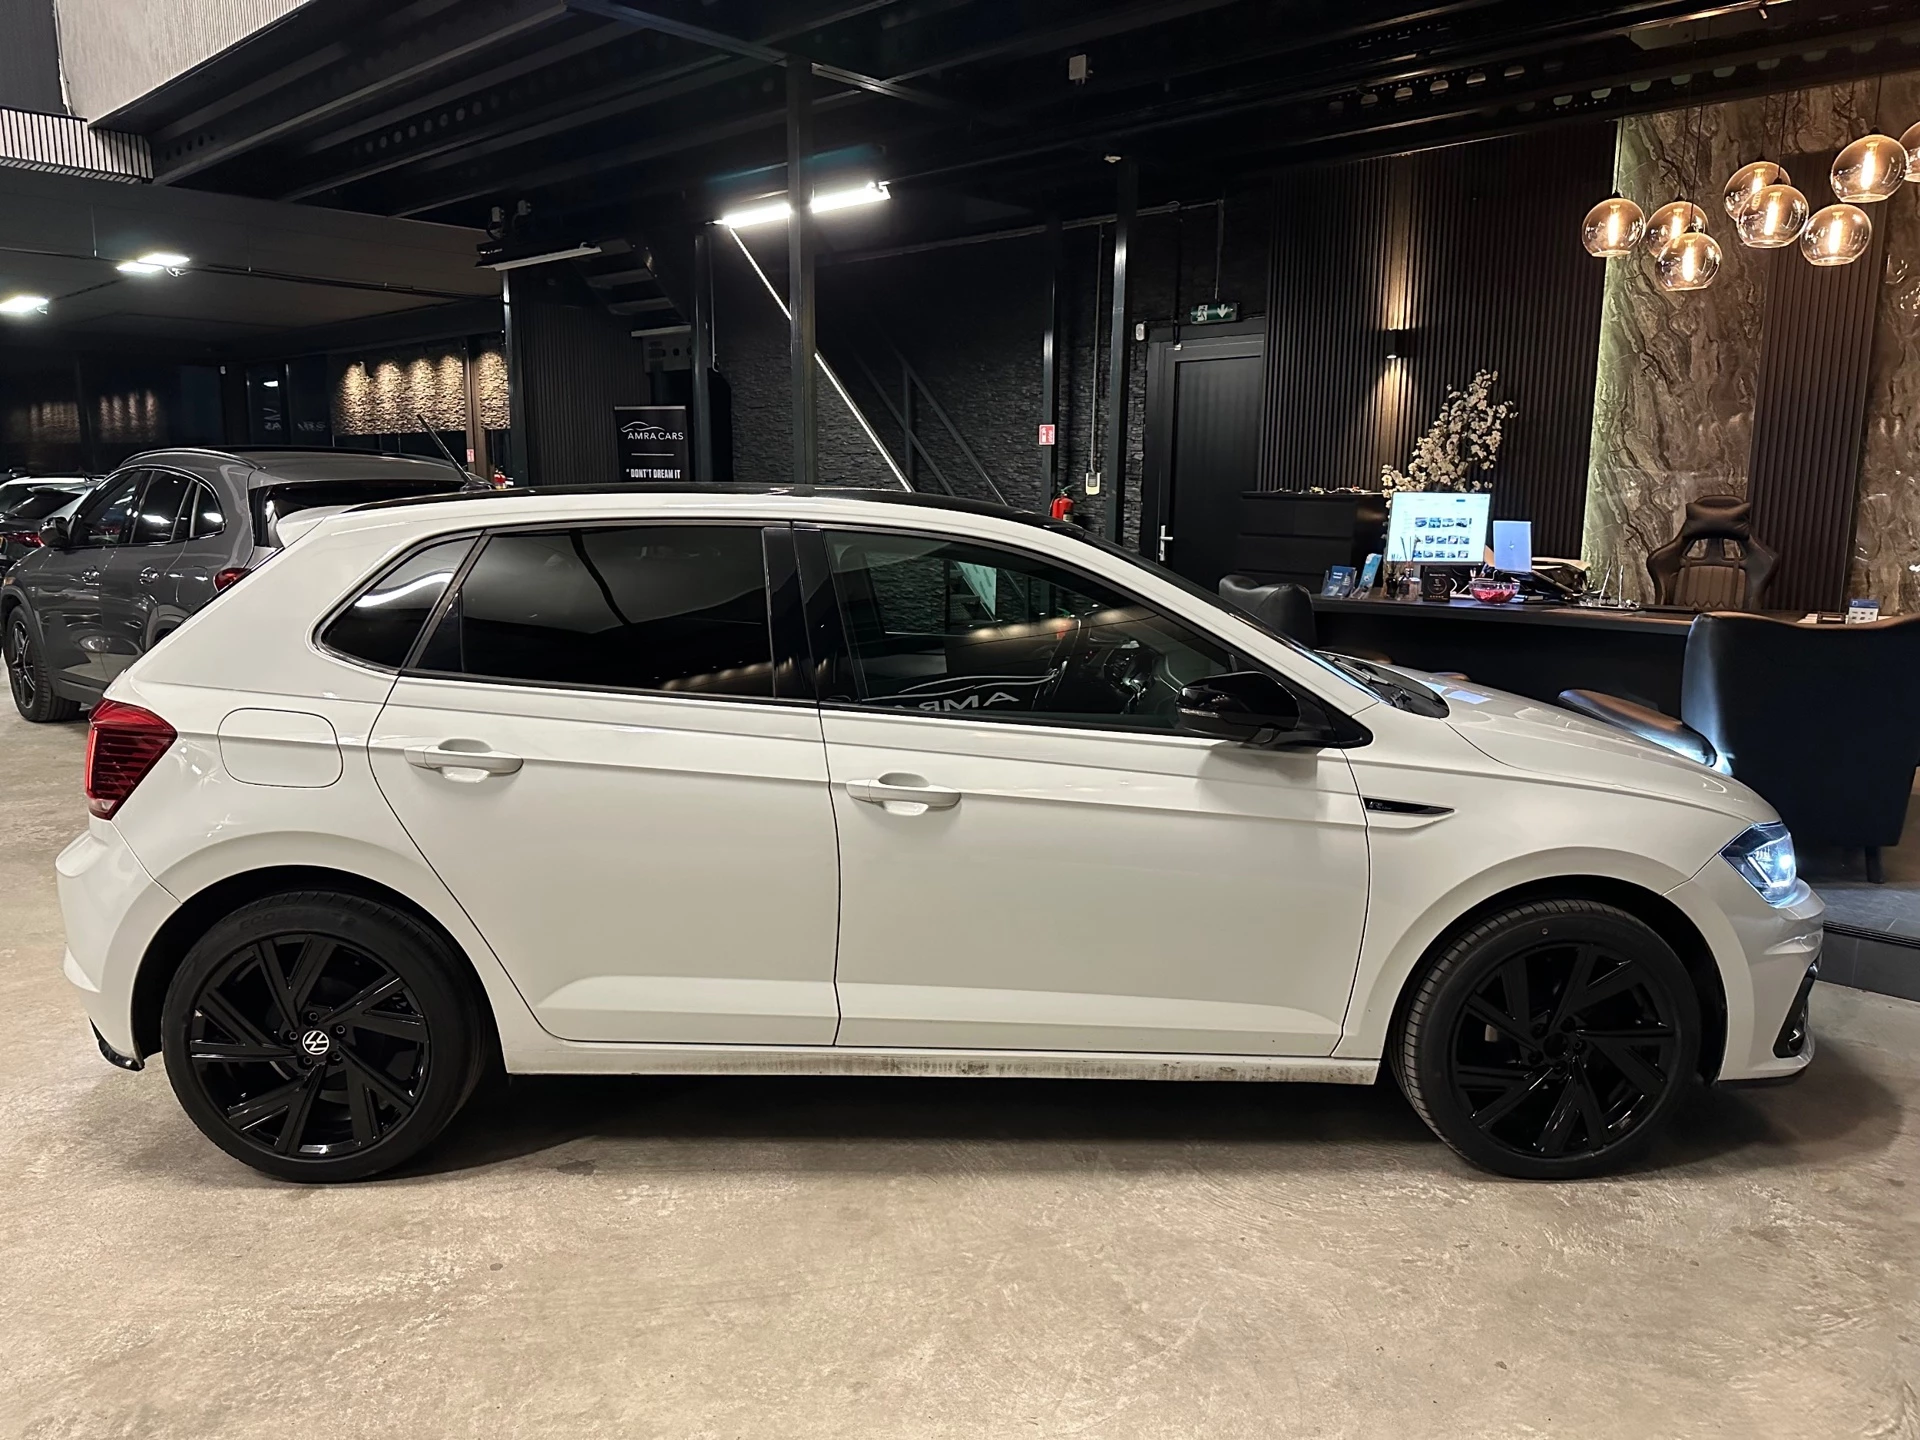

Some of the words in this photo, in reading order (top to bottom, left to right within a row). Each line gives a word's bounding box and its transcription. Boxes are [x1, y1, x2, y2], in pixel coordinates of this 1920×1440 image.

[627, 432, 657, 440] AMRA
[658, 432, 684, 440] CARS
[653, 468, 674, 479] DREAM
[674, 469, 681, 479] IT
